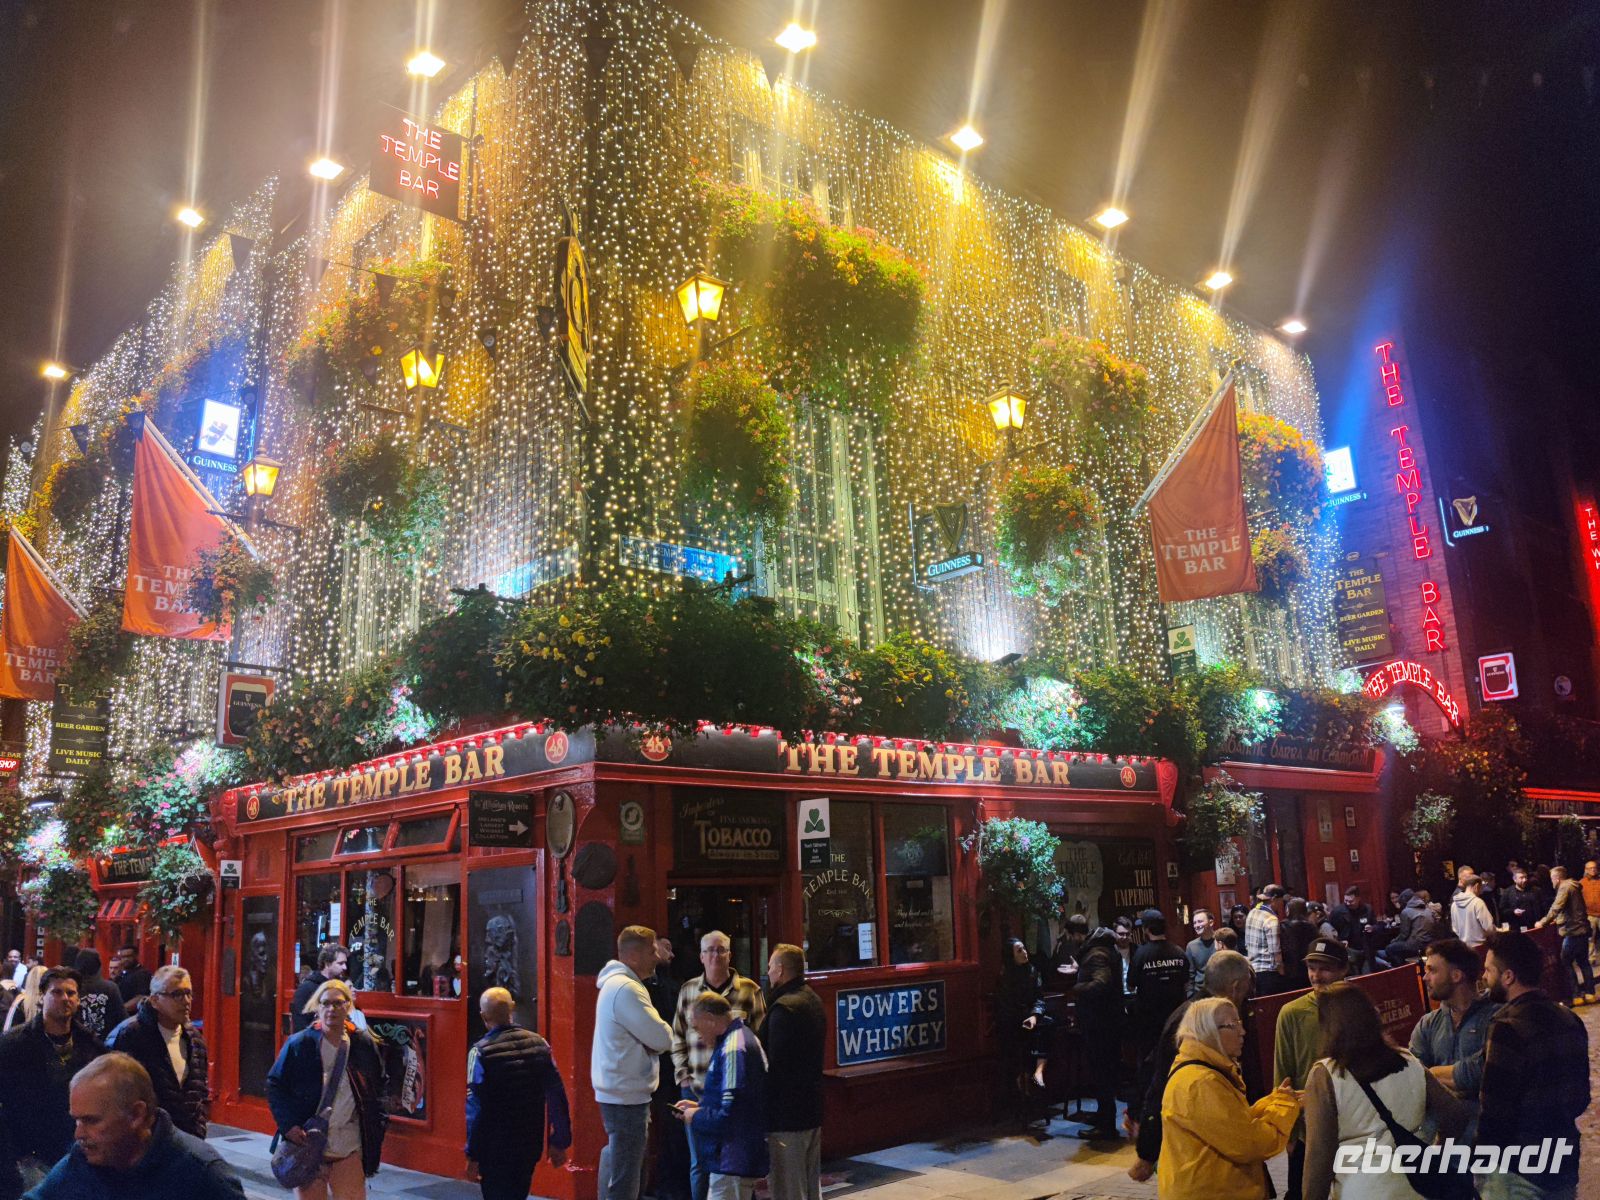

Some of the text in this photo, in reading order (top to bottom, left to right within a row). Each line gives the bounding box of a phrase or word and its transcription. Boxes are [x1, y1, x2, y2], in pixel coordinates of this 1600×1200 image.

[402, 118, 442, 150] THE
[381, 134, 460, 181] TEMPLE
[399, 169, 439, 199] BAR
[193, 455, 238, 473] GUINNESS
[1375, 342, 1445, 651] THE TEMPLE BAR
[1184, 526, 1217, 542] THE
[1453, 526, 1485, 539] GUINNESS
[1161, 535, 1243, 560] TEMPLE
[163, 565, 192, 578] TH
[928, 554, 971, 576] GUINNESS
[1184, 556, 1227, 575] BAR
[1349, 568, 1365, 578] THE
[1336, 574, 1382, 591] TEMPLE
[1346, 588, 1372, 600] BAR
[1357, 608, 1384, 619] GARDEN
[1343, 634, 1386, 647] LIVE MUSIC
[1354, 643, 1377, 652] DAILY
[27, 645, 56, 658] THE
[20, 669, 55, 683] BAR
[1366, 661, 1459, 726] THE TEMPLE BAR
[55, 722, 105, 732] BEER GARDEN
[76, 750, 102, 758] MUSIC
[781, 741, 1071, 785] THE TEMPLE BAR
[284, 745, 506, 813] THE TEMPLE BAR
[695, 819, 772, 855] TOBACCO
[830, 853, 846, 863] THE
[1067, 848, 1087, 860] THE
[1060, 861, 1097, 874] TEMPLE
[803, 869, 849, 900] TEMPLE
[1135, 869, 1153, 887] THE
[1114, 888, 1156, 907] EMPEROR
[380, 916, 395, 942] BAR
[1143, 958, 1184, 971] ALLSAINTS
[840, 1020, 944, 1056] WHISKEY
